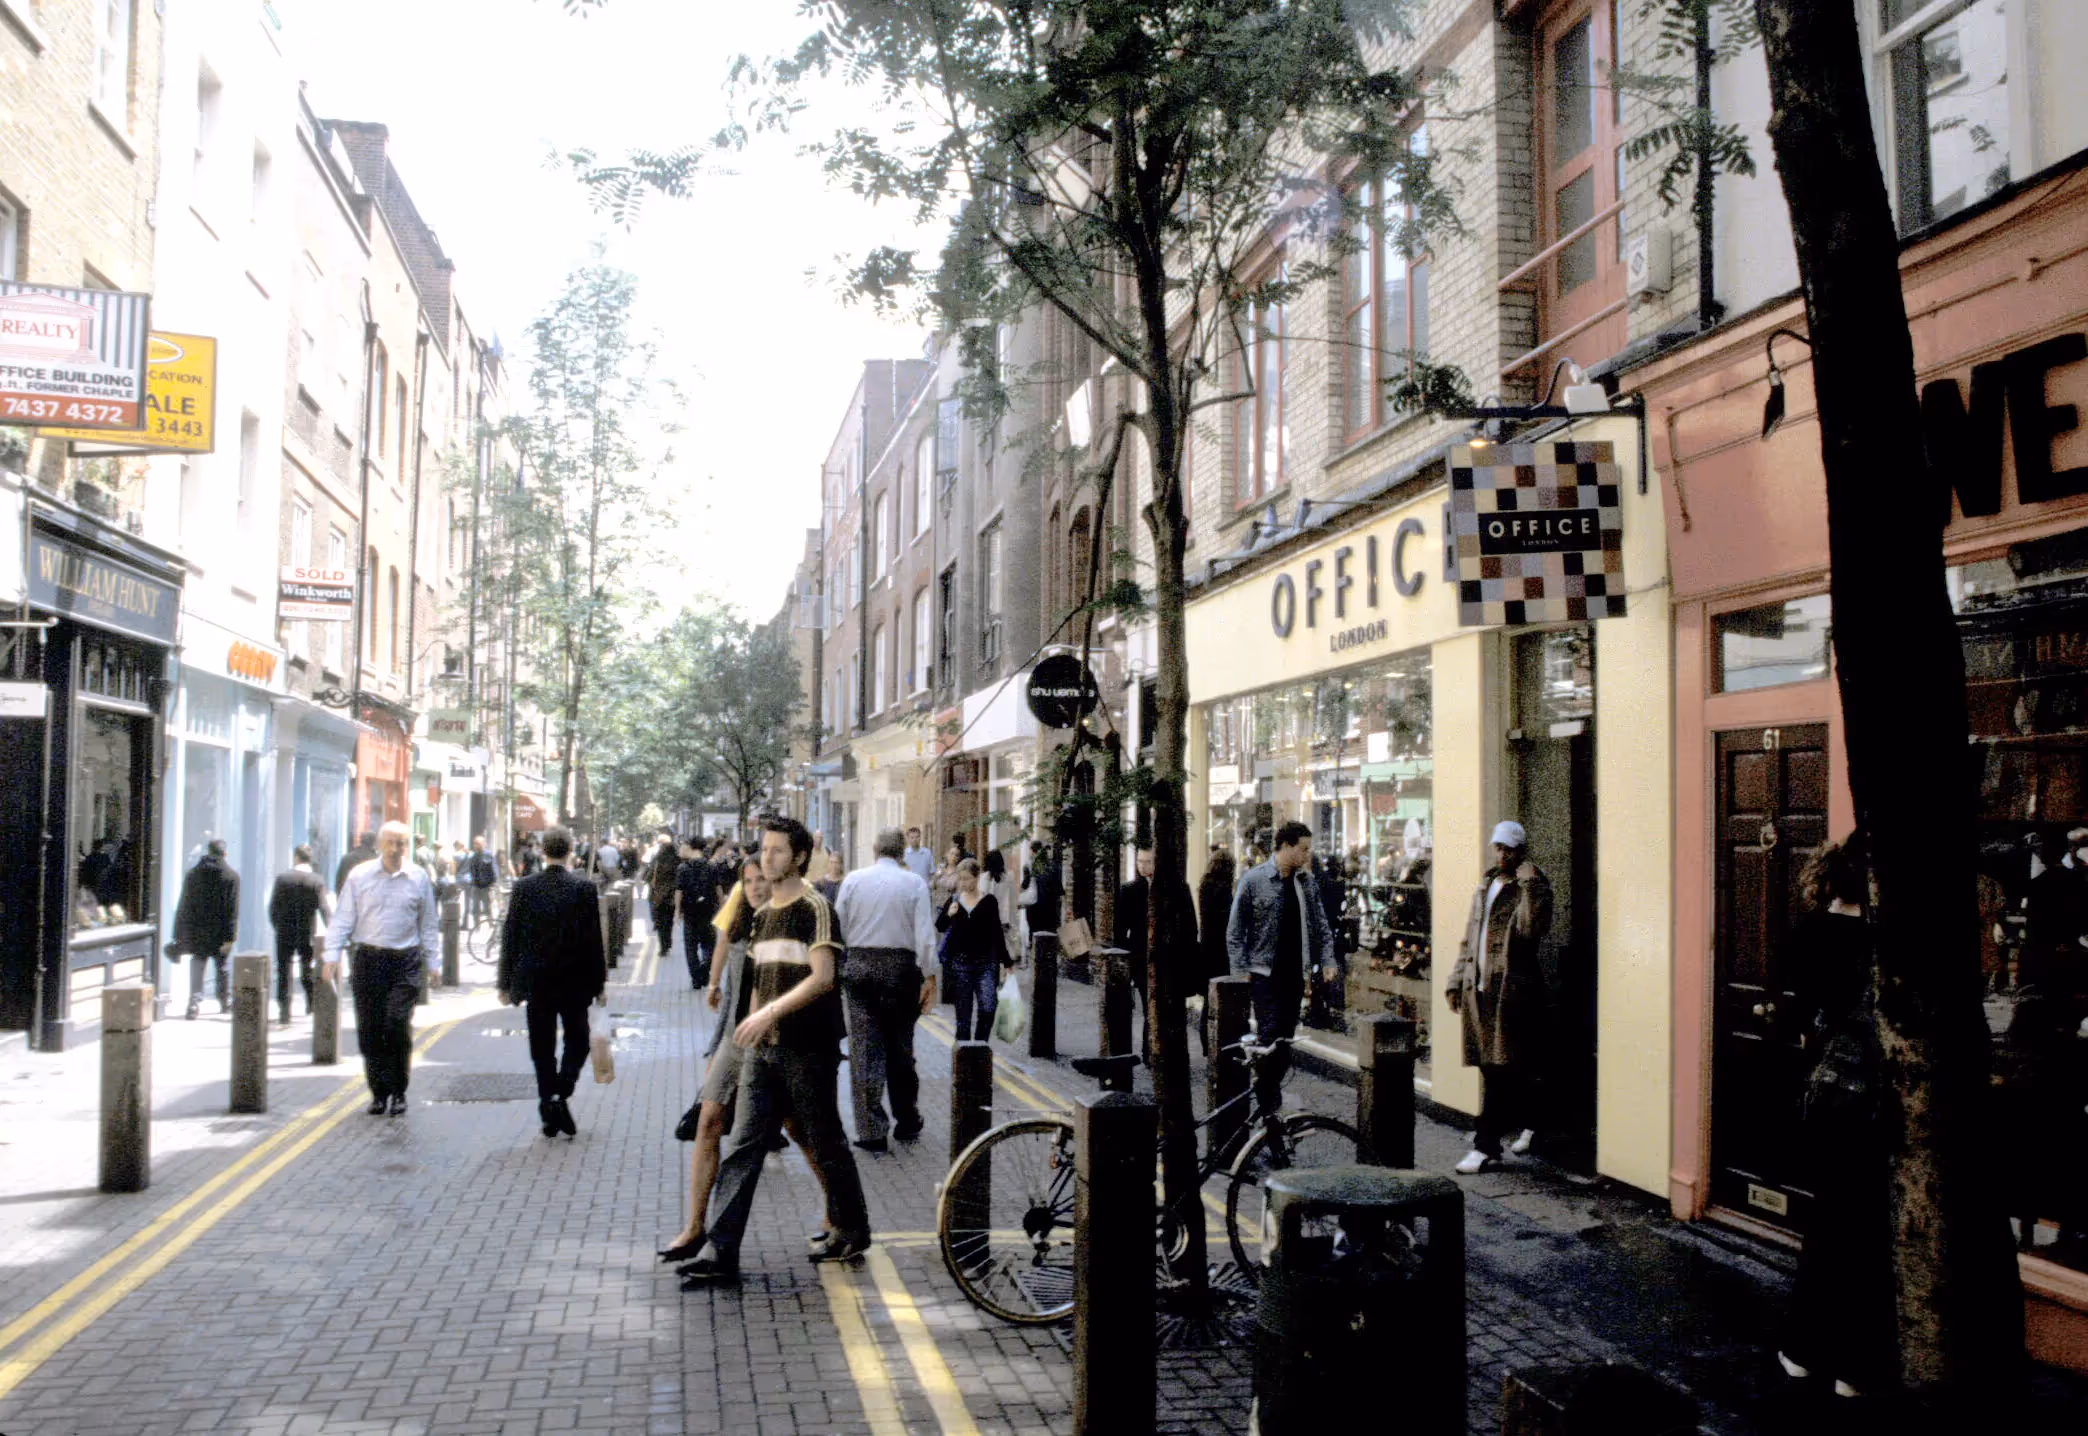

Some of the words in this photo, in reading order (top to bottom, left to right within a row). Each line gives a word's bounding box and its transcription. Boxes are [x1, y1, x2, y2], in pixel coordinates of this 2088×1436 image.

[1, 319, 79, 340] REALTY
[53, 369, 134, 387] BUILDING
[27, 381, 80, 394] FORMER
[83, 385, 134, 399] CHAPLE
[4, 397, 60, 418] 7437
[65, 402, 123, 424] 4372
[156, 417, 203, 437] 3443
[1488, 517, 1592, 539] OFFICE
[295, 567, 345, 581] SOLD
[281, 583, 353, 599] Winkworth
[1330, 619, 1388, 653] LONDON
[1763, 728, 1780, 751] 61
